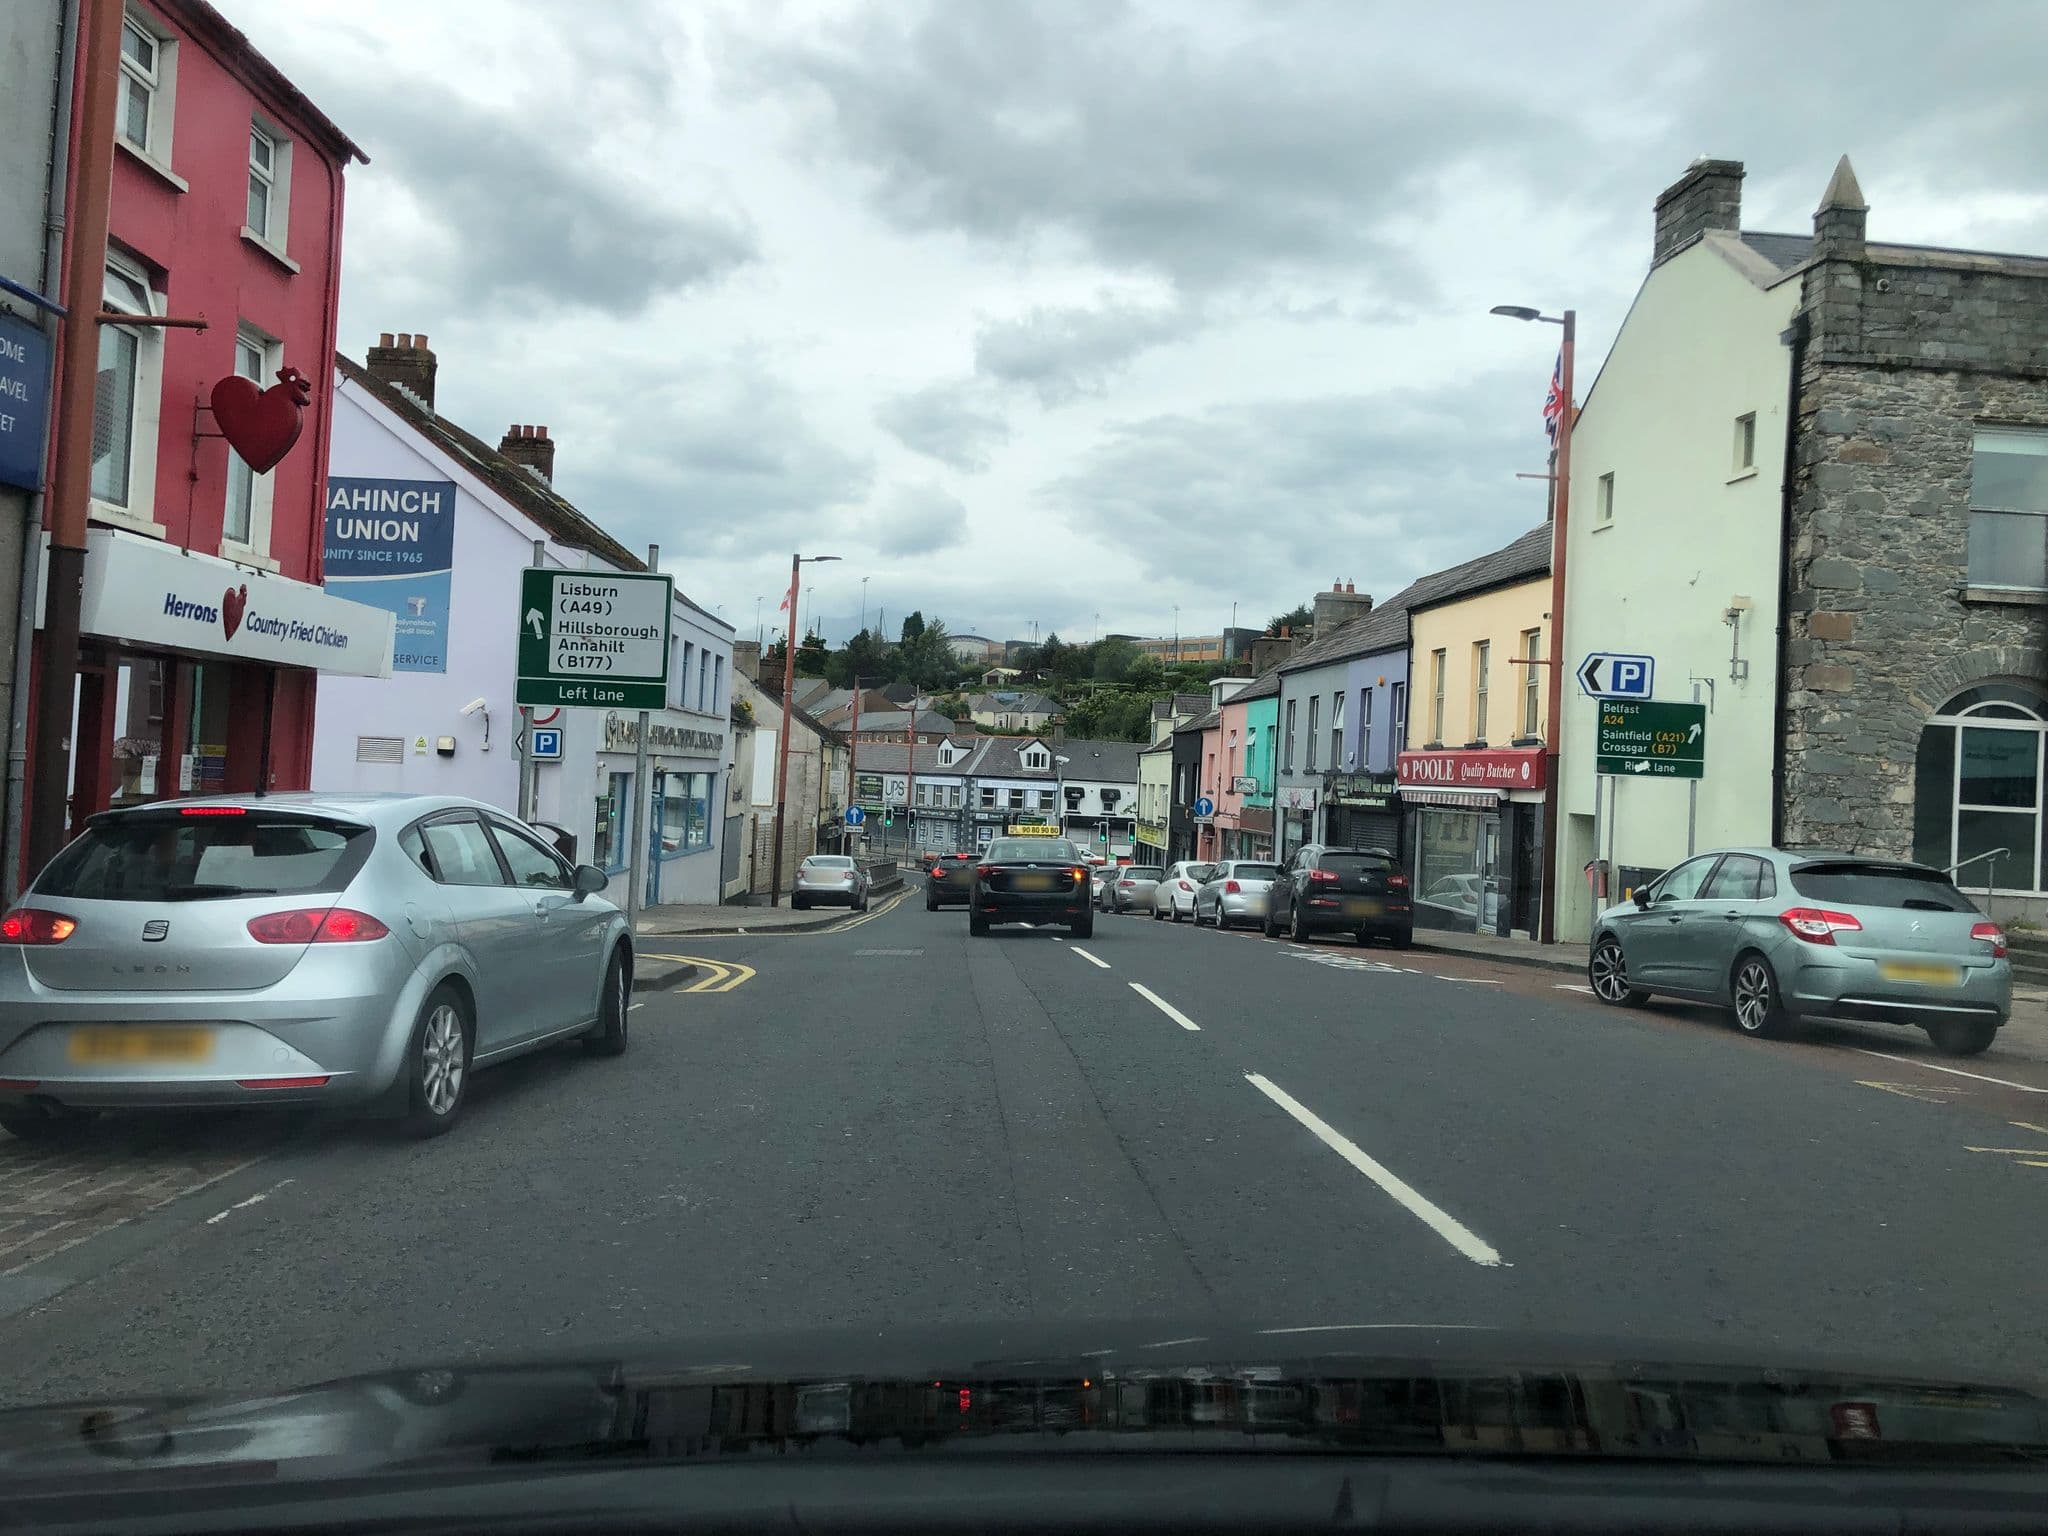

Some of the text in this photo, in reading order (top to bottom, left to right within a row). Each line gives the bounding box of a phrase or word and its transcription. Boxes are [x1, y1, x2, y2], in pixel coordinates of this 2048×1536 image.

[0, 412, 16, 433] ET
[326, 487, 441, 514] AHINCH
[336, 517, 420, 542] UNION
[356, 550, 393, 562] SINCE
[395, 552, 424, 563] 1965
[560, 582, 619, 598] Lisburn
[560, 598, 613, 616] (A49)
[163, 592, 349, 649] Herrons Country Fried Chicken
[558, 620, 659, 640] Hillsborough
[558, 638, 625, 653] Annahilt
[393, 654, 440, 666] SERVICE
[557, 653, 613, 671] (B177)
[1619, 663, 1641, 690] P
[558, 686, 625, 701] Left lane
[1603, 703, 1640, 714] Belfast
[1603, 715, 1625, 725] A24
[539, 735, 553, 752] P
[1602, 730, 1686, 744] Saintfield (A21)
[1602, 742, 1677, 755] Crossgar (B7)
[1412, 759, 1516, 781] POOLE Quality Butcher
[1654, 763, 1676, 773] lane
[1022, 826, 1031, 834] 90
[1031, 826, 1040, 834] 80
